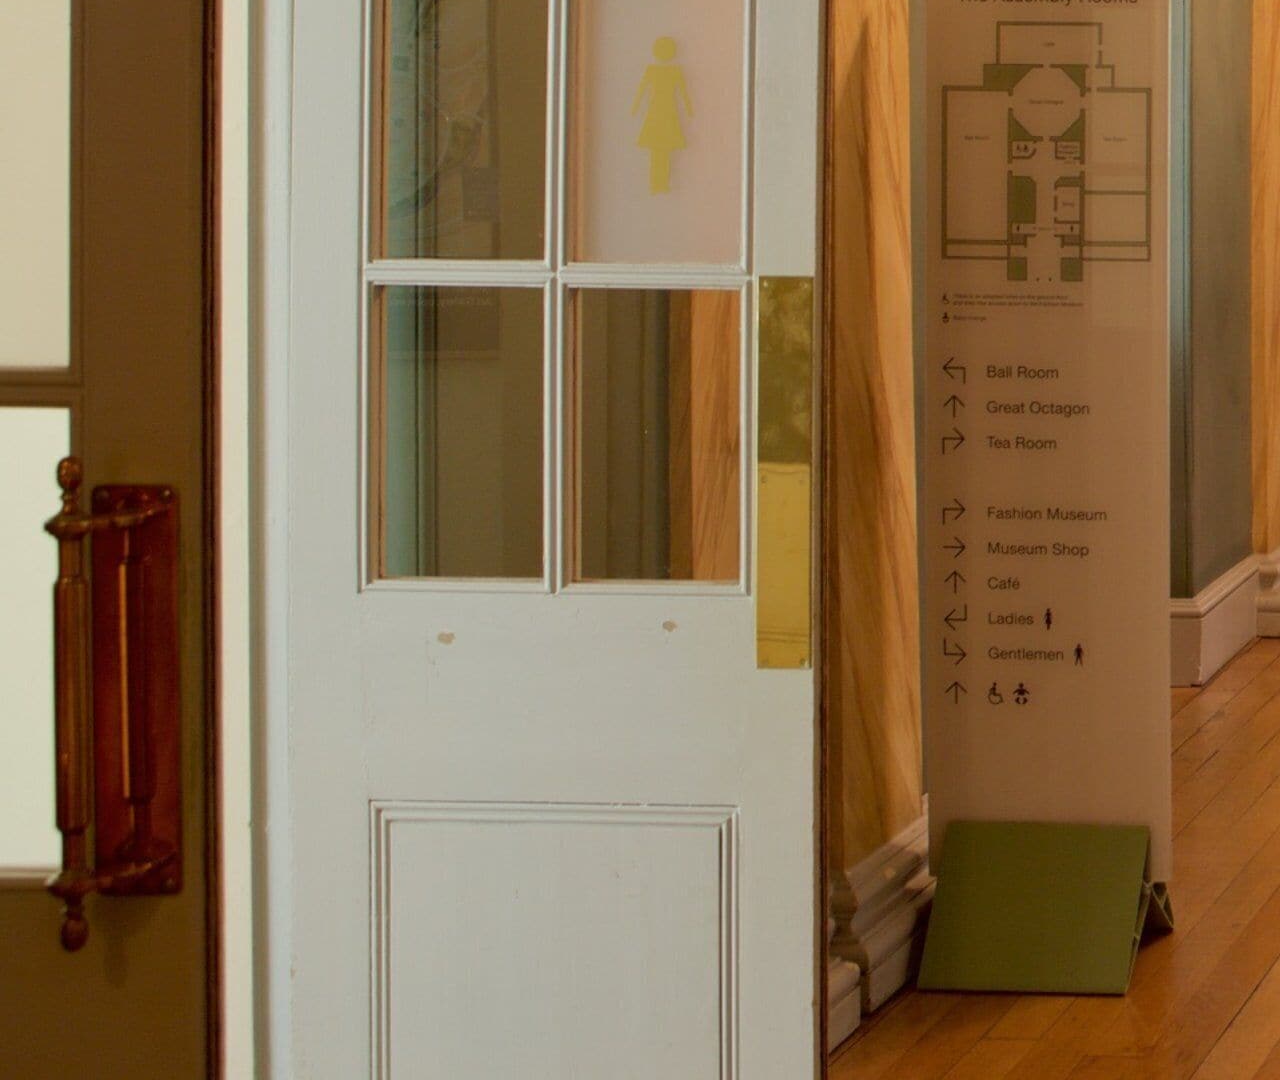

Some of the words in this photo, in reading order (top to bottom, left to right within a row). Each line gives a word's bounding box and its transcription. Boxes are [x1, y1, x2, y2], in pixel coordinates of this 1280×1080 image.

[986, 364, 1012, 379] Ball
[1016, 365, 1059, 380] Room
[986, 400, 1025, 415] Great
[1029, 400, 1091, 418] Octagon
[986, 435, 1012, 450] Tea
[1015, 436, 1057, 451] Room
[987, 506, 1042, 521] Fashion
[1046, 507, 1107, 522] Museum
[987, 541, 1047, 556] Museum
[1052, 542, 1090, 559] Shop
[987, 575, 1020, 591] Café
[988, 611, 1034, 626] Ladies
[988, 646, 1064, 662] Gentlemen
